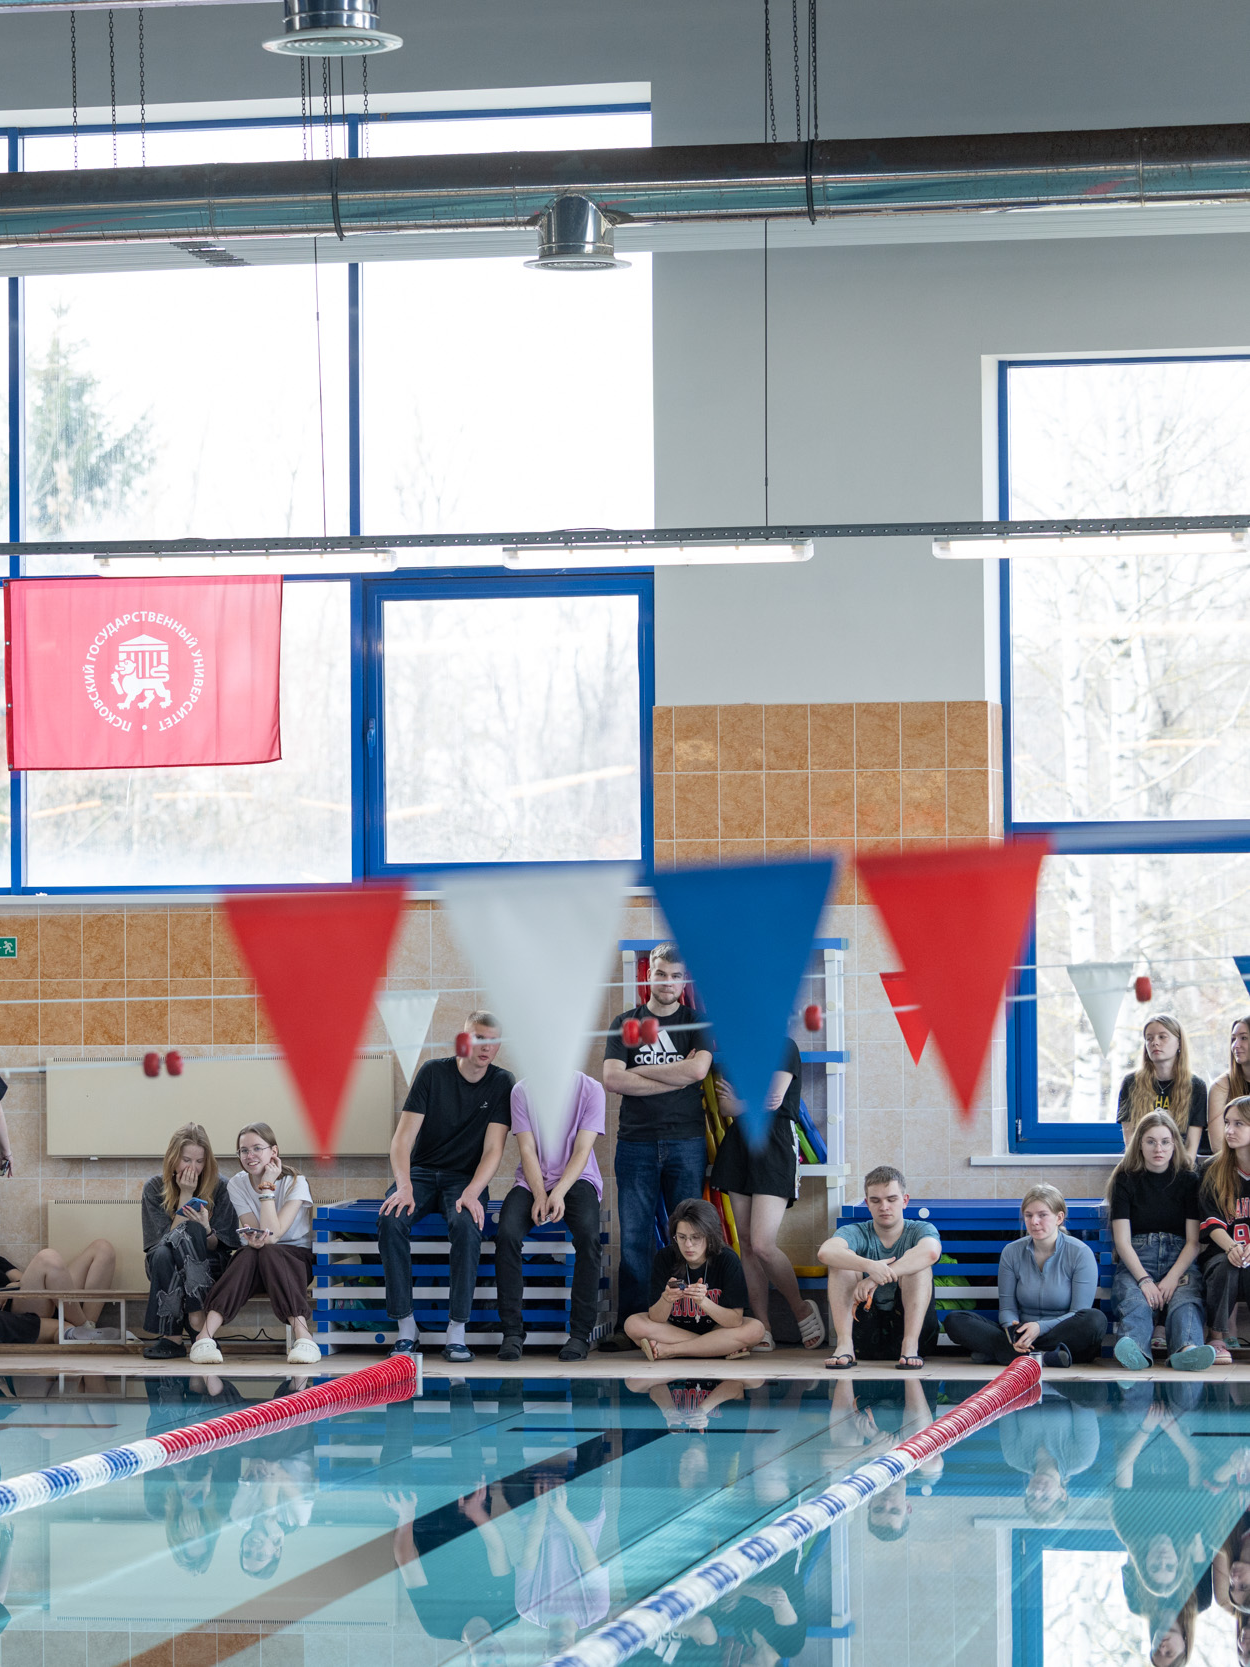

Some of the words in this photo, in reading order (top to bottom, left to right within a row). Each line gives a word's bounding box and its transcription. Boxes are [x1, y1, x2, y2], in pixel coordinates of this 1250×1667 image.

[86, 611, 199, 662] ГОСУДАРСТВЕННЫЙ
[82, 664, 132, 732] ПСКОВСКИЙ
[158, 649, 205, 732] УНИВЕРСИТЕТ
[634, 1051, 685, 1065] adidas
